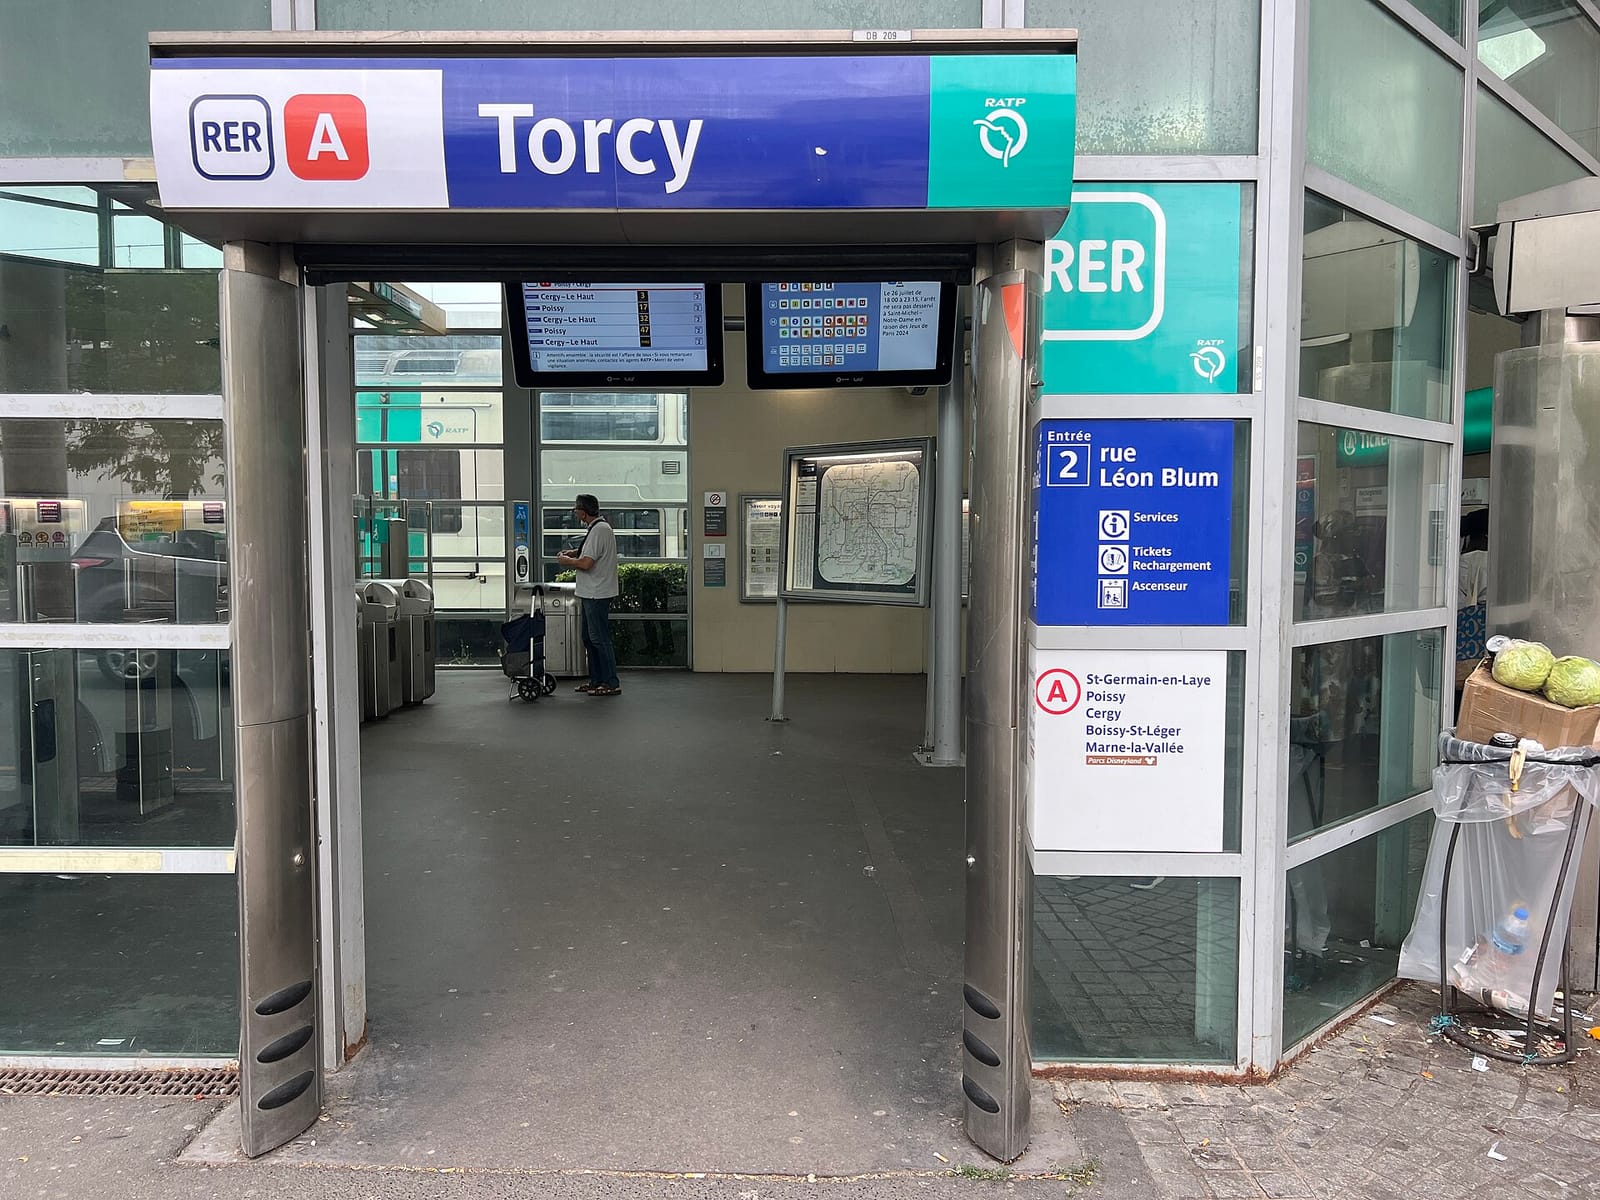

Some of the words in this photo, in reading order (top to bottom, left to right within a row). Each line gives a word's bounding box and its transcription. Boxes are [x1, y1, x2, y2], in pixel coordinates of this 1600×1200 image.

[882, 31, 897, 40] 209
[984, 97, 1027, 107] RATP
[201, 121, 263, 153] RER
[306, 112, 350, 161] A
[477, 102, 704, 194] Torcy
[1044, 239, 1145, 293] RER
[542, 304, 564, 313] Poissy
[544, 327, 566, 335] Poissy
[1047, 430, 1092, 442] Entrée
[1059, 450, 1078, 479] 2
[1100, 446, 1137, 462] rue
[1100, 467, 1153, 487] Léon
[1161, 467, 1218, 487] Blum
[1133, 512, 1179, 523] Services
[1133, 546, 1172, 557] Tickets
[1132, 560, 1212, 573] Rechargement
[1131, 581, 1188, 591] Ascenseur
[1046, 679, 1068, 703] A
[1086, 674, 1211, 688] St-Germain-en-Laye
[1086, 691, 1126, 704] Poissy
[1086, 707, 1122, 721] Cergy
[1086, 724, 1181, 739] Boissy-St-Léger
[1086, 742, 1184, 754] Marne-la-Vallée
[1106, 757, 1143, 765] Disneyland
